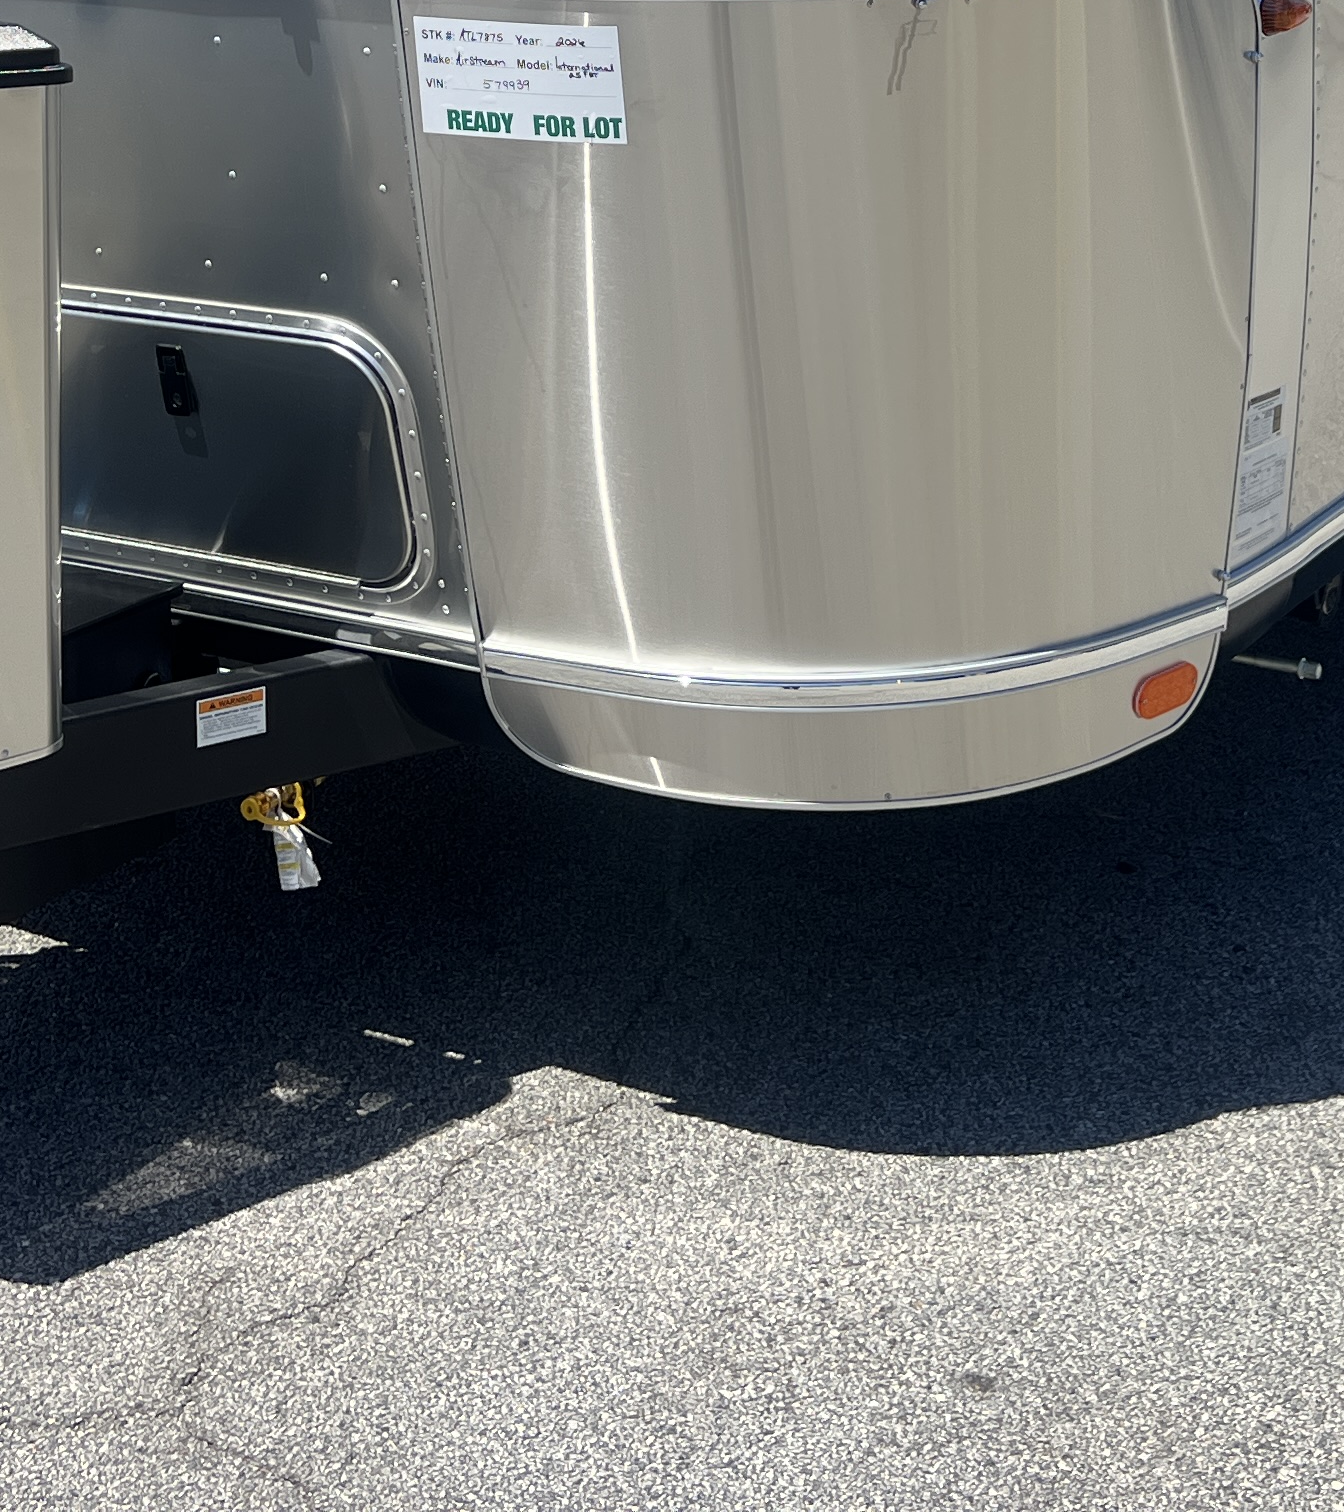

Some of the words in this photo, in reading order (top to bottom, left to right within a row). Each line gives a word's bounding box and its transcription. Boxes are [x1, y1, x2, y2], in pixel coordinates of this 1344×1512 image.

[421, 29, 443, 41] STK
[515, 34, 543, 46] Year:
[423, 52, 453, 65] Make:
[516, 58, 553, 71] Model:
[425, 77, 447, 89] VIN:
[483, 78, 530, 91] 579939
[446, 108, 514, 134] READY
[533, 114, 576, 138] FOR
[582, 116, 622, 139] LOT
[218, 694, 253, 707] WARNING
